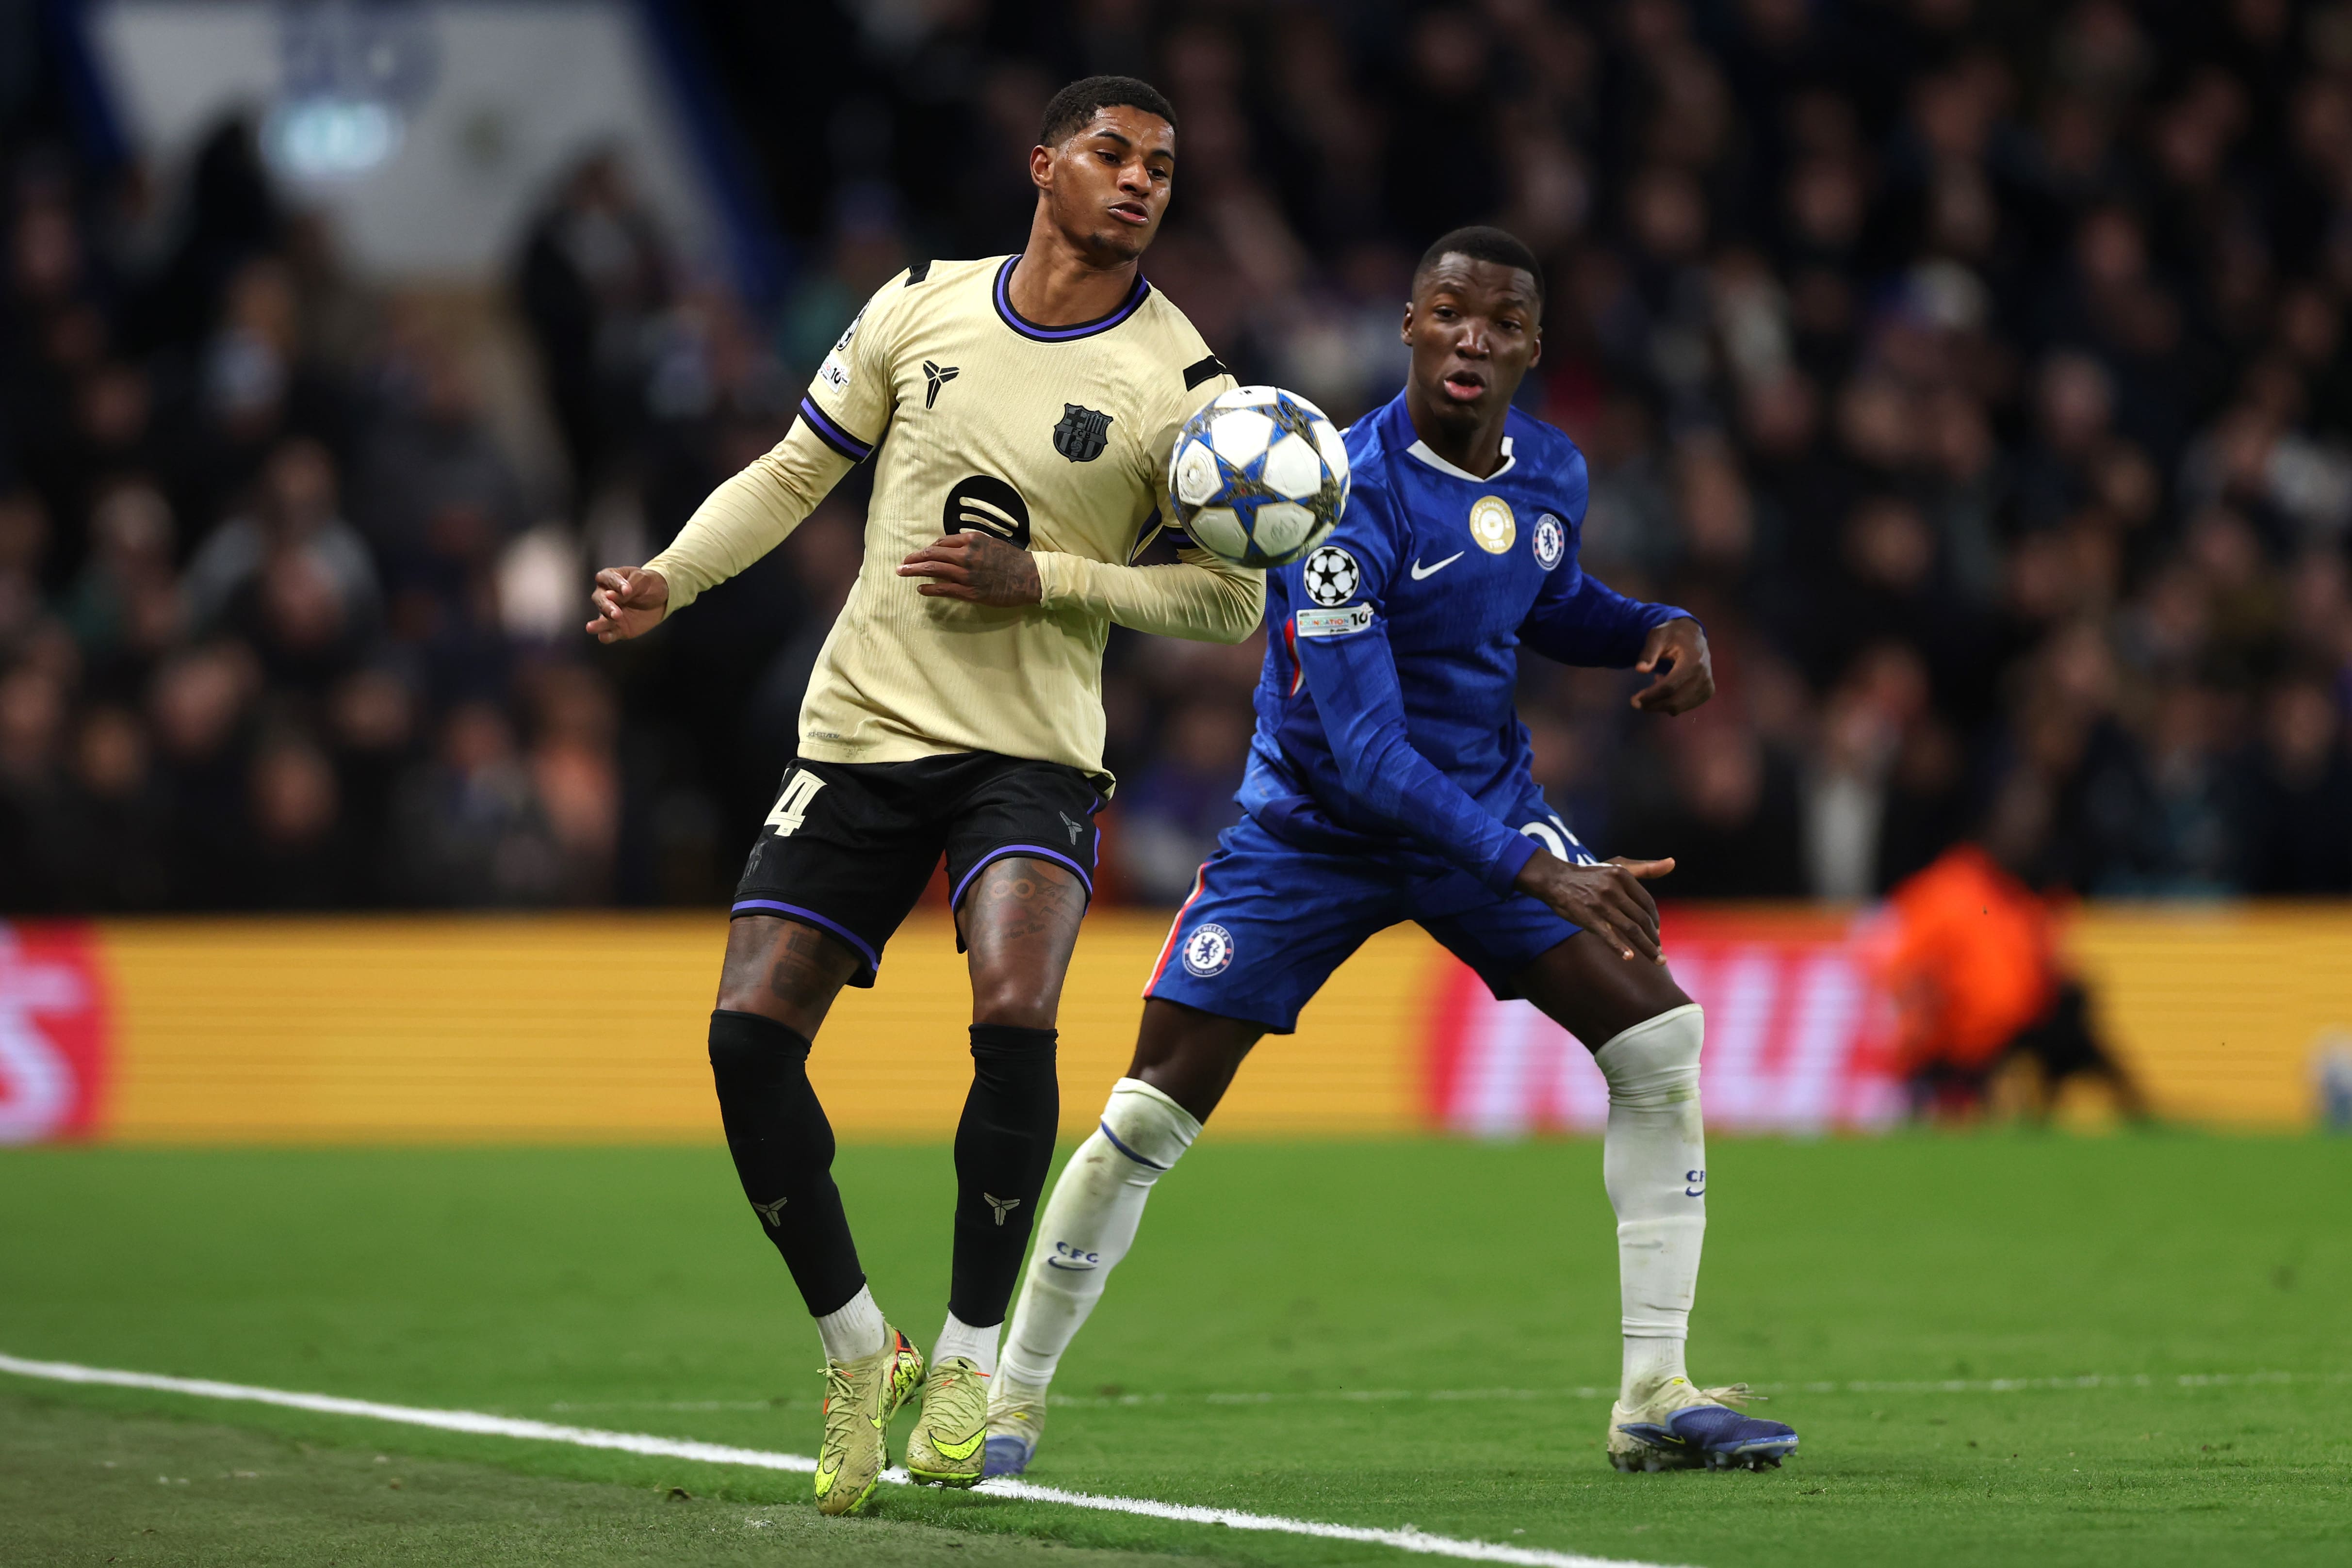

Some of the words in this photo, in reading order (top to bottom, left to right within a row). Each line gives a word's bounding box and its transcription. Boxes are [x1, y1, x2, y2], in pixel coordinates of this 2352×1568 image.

[831, 367, 841, 384] 10
[1071, 428, 1091, 439] FCB
[764, 768, 828, 837] 4
[1197, 926, 1228, 942] CHELSEA
[1056, 1241, 1099, 1263] CFC
